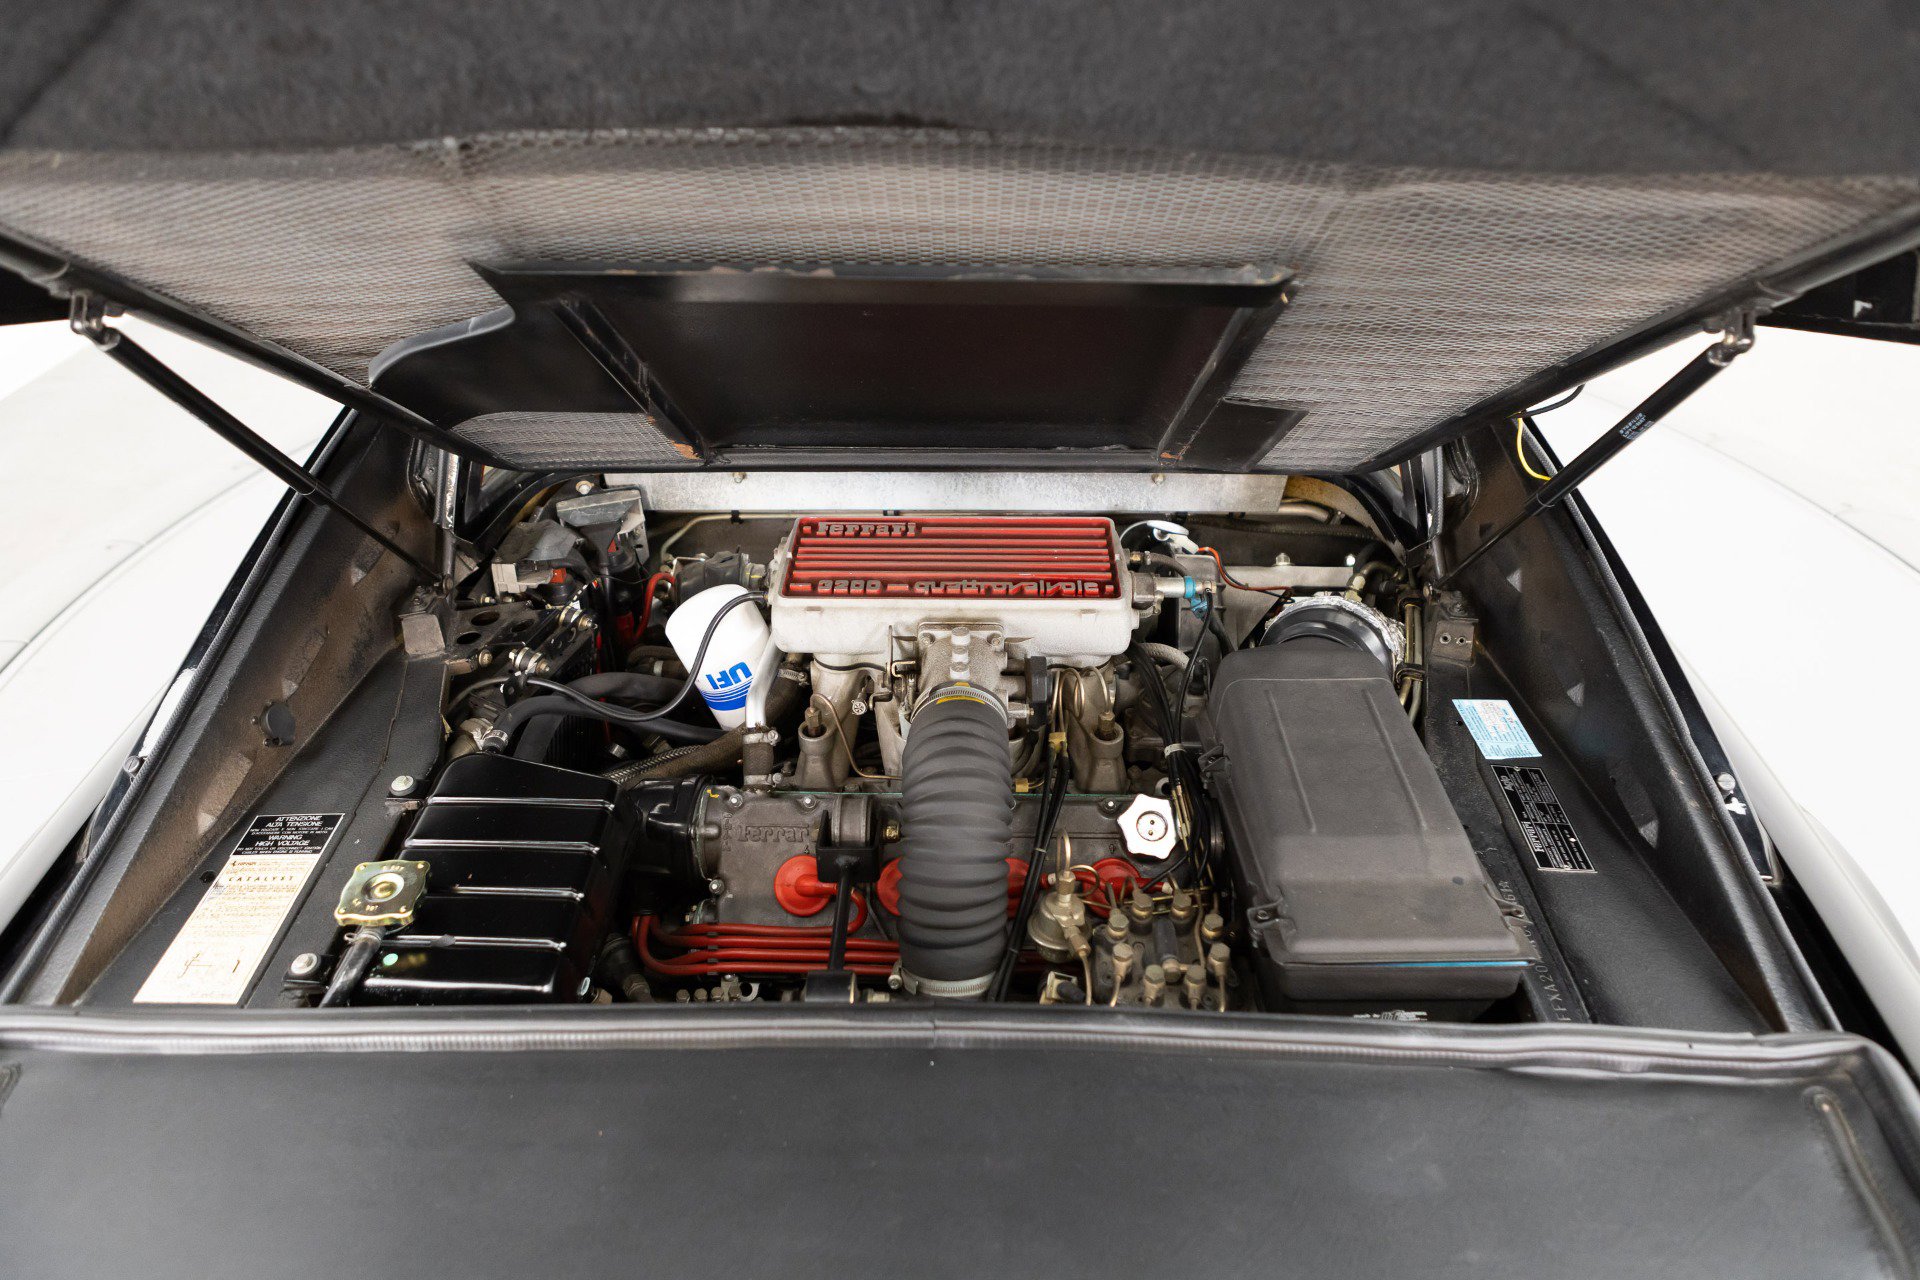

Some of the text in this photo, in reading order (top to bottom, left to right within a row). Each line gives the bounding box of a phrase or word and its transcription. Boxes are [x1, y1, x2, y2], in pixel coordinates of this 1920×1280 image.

[816, 521, 916, 537] Ferrari
[914, 579, 1100, 597] quattrovalvole
[705, 661, 753, 691] UFI
[736, 824, 817, 843] Ferrar
[1521, 821, 1545, 853] Ferrari
